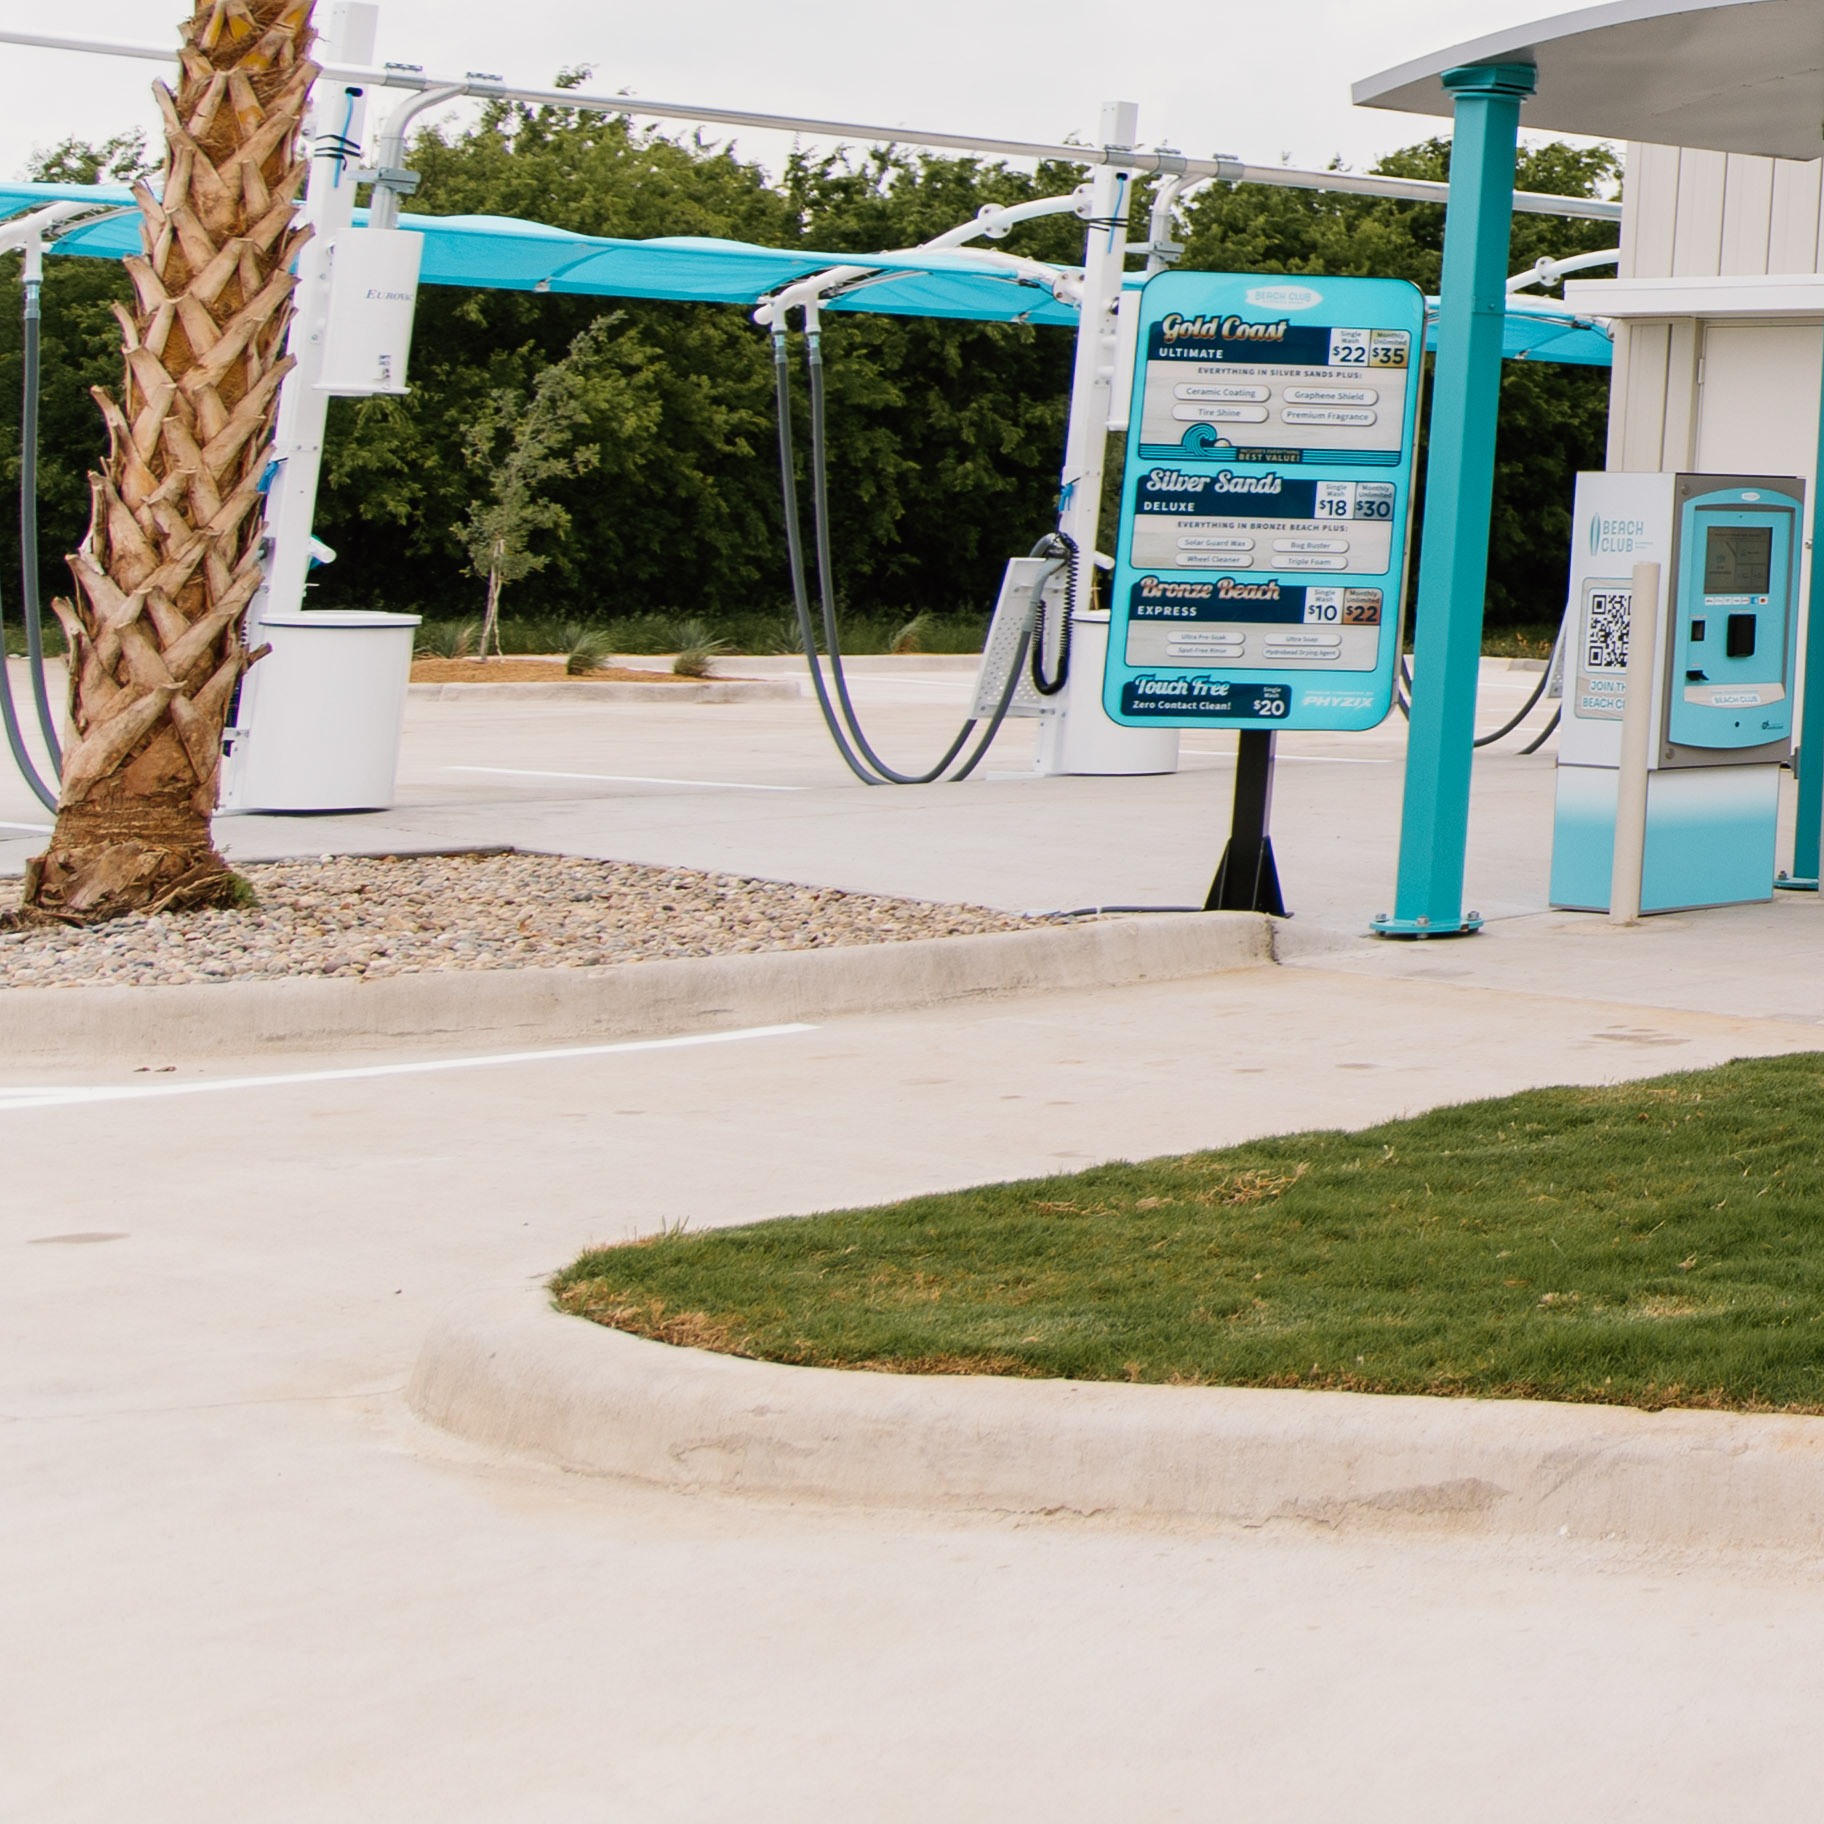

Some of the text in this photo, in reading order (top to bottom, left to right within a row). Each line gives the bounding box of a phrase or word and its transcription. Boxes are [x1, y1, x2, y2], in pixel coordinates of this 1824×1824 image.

[1255, 290, 1312, 302] BEACH CLUB
[1163, 314, 1288, 344] Gold Coast
[1340, 330, 1361, 338] Single
[1377, 332, 1404, 340] Monthly
[1373, 338, 1407, 346] Unlimited
[1159, 347, 1224, 358] ULTIMATE
[1332, 345, 1366, 363] $22
[1372, 347, 1405, 364] $35
[1197, 367, 1255, 375] EVERYTHING
[1304, 370, 1333, 378] SANDS
[1336, 371, 1362, 379] PLUS:
[1186, 387, 1256, 398] Ceramic Coating
[1294, 391, 1364, 401] Graphene Shield
[1198, 408, 1241, 417] Tire Shine
[1286, 411, 1369, 422] Premium Fragrance
[1265, 454, 1300, 462] VALUE!
[1146, 469, 1282, 494] Silver Sands
[1326, 484, 1347, 492] Single
[1362, 484, 1390, 492] Monthly
[1143, 501, 1195, 512] DELUXE
[1319, 499, 1347, 516] $18
[1355, 500, 1391, 517] $30
[1177, 521, 1235, 529] EVERYTHING
[1250, 522, 1286, 530] BRONZE
[1602, 520, 1644, 536] BEACH
[1184, 538, 1203, 546] Solar
[1290, 541, 1331, 549] Bug Buster
[1601, 537, 1634, 552] CLUB
[1140, 576, 1280, 600] Bronze Beach
[1314, 589, 1336, 597] Single
[1349, 590, 1378, 598] Monthly
[1137, 606, 1197, 616] EXPRESS
[1308, 605, 1338, 621] $10
[1346, 606, 1378, 622] $22
[1135, 676, 1230, 696] Touch Free
[1591, 680, 1614, 691] JOIN
[1132, 700, 1232, 711] Zero Contact Clean!
[1253, 699, 1285, 716] $20
[1302, 697, 1375, 709] PHYZIX
[1583, 697, 1613, 708] BEACH
